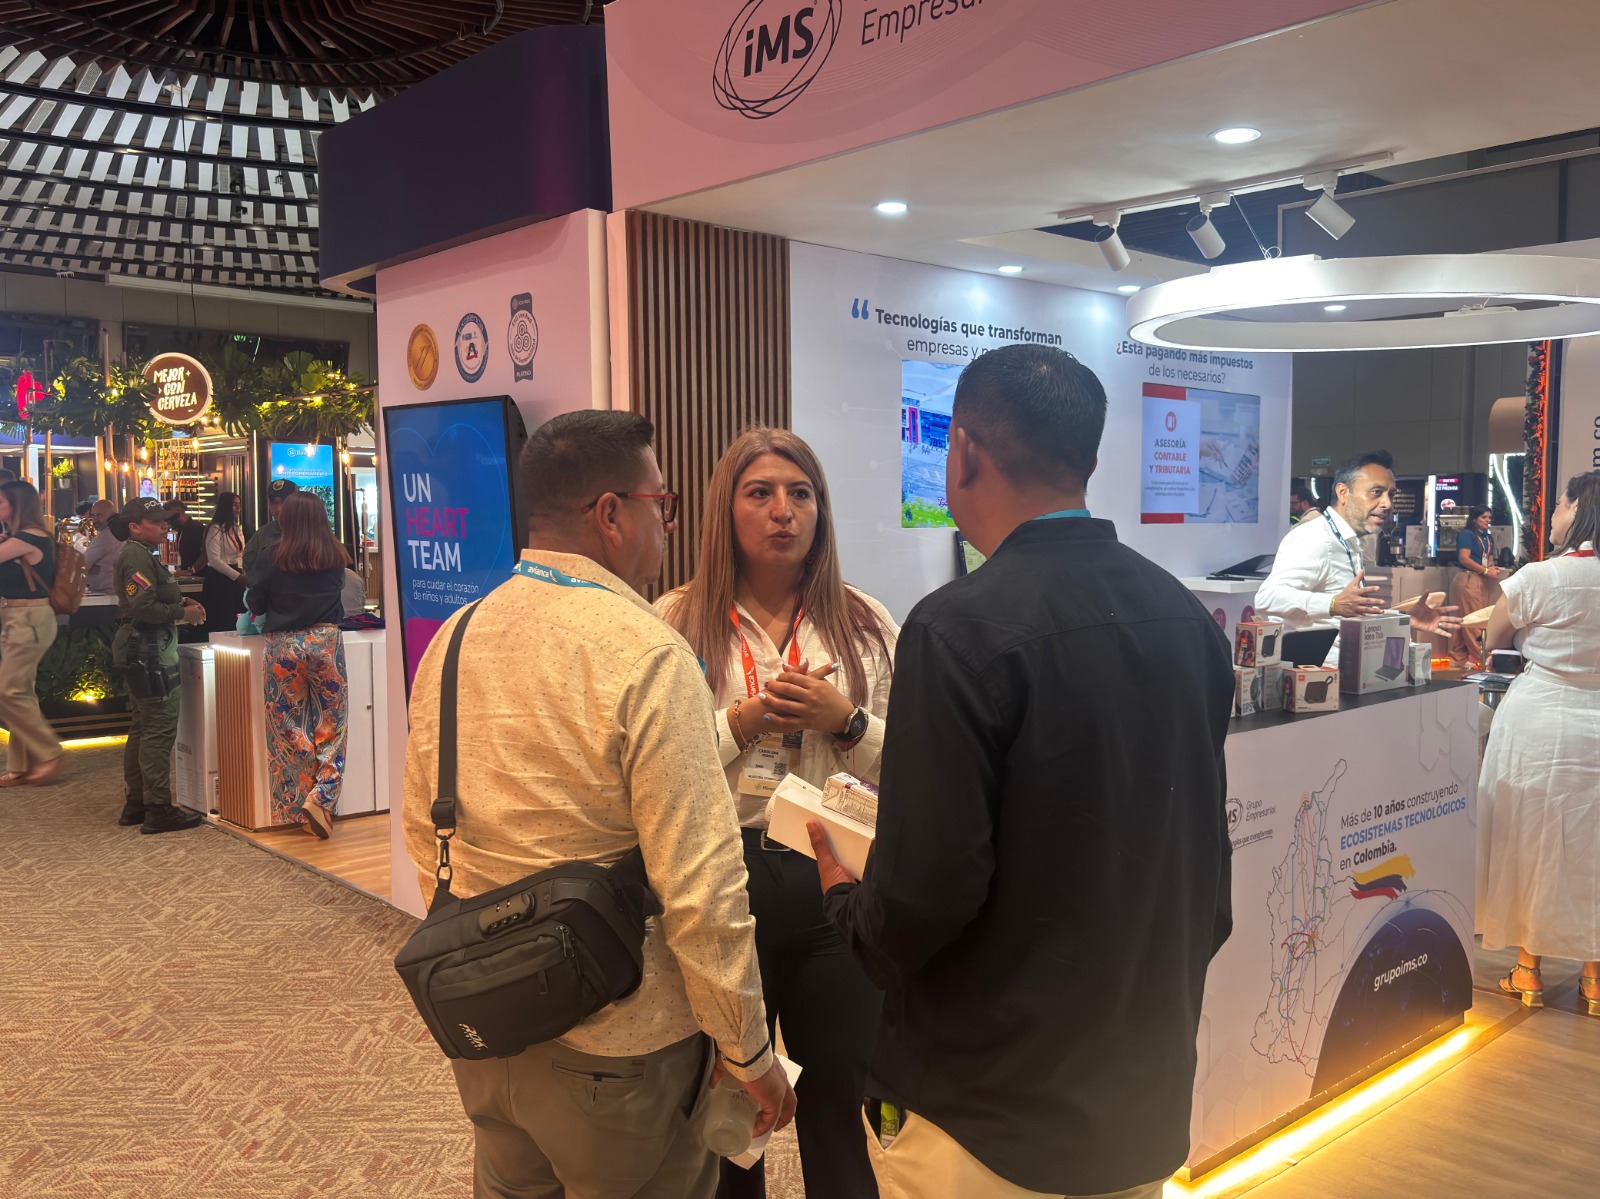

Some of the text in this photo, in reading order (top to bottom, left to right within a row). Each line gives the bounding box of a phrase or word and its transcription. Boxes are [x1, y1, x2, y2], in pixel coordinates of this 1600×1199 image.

[744, 7, 814, 77] iMS
[875, 308, 1062, 345] Tecnologías que transforman
[907, 338, 969, 357] empresas
[971, 346, 979, 360] y
[1116, 340, 1253, 370] ¿Está pagando más impuestos
[153, 366, 185, 383] MEJOR
[1148, 363, 1226, 384] de los necesarios?
[163, 380, 186, 396] CON
[157, 392, 198, 411] CERVEZA
[1155, 437, 1186, 449] ASESORÍA
[1154, 451, 1187, 461] CONTABLE
[1149, 464, 1191, 475] Y TRIBUTARIA
[403, 473, 432, 503] UN
[406, 507, 469, 539] HEART
[408, 540, 462, 572] TEAM
[527, 565, 550, 578] avianca
[412, 578, 480, 593] para cuidar el corazón
[413, 590, 468, 606] de niños y adultos
[1364, 625, 1382, 633] Lenovo
[1246, 800, 1263, 811] Grupo
[1246, 804, 1277, 822] Empresarial
[1341, 782, 1459, 829] Más de 10 años construyendo
[1340, 797, 1466, 850] ECOSISTEMAS TECNOLÓGICOS
[1339, 839, 1397, 870] en Colombia.
[1373, 953, 1428, 992] grupoims.co
